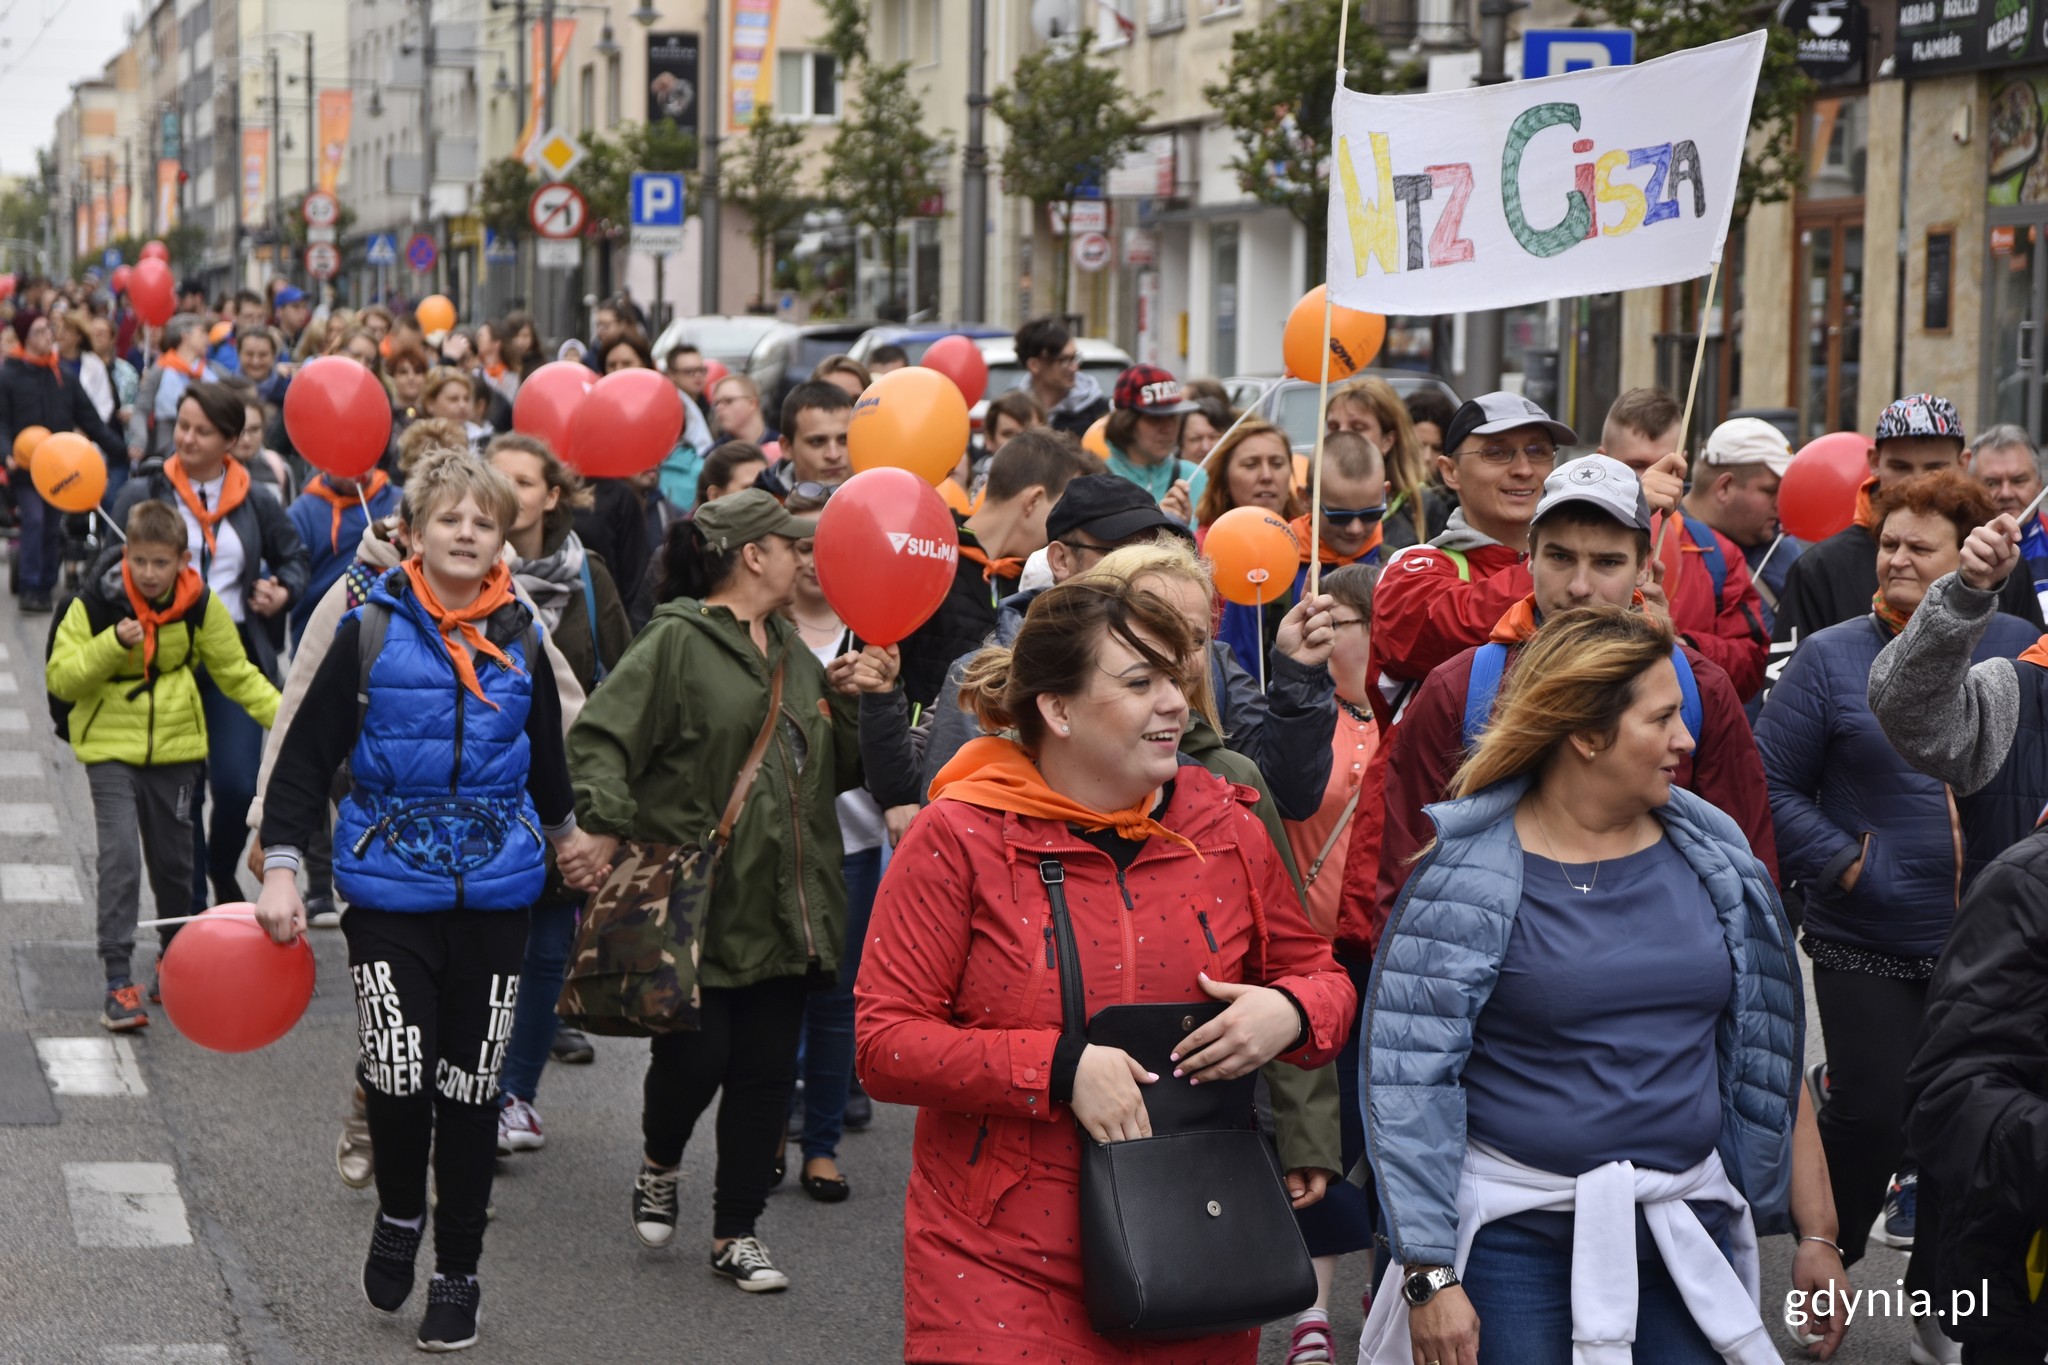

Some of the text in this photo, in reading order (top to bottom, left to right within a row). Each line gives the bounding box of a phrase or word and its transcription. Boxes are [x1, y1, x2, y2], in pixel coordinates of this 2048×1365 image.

[1900, 2, 1936, 27] KEBAB
[1943, 0, 1980, 19] ROLLO
[1986, 5, 2029, 53] KEBAB
[641, 177, 676, 221] P
[1338, 131, 1475, 278] WTZ
